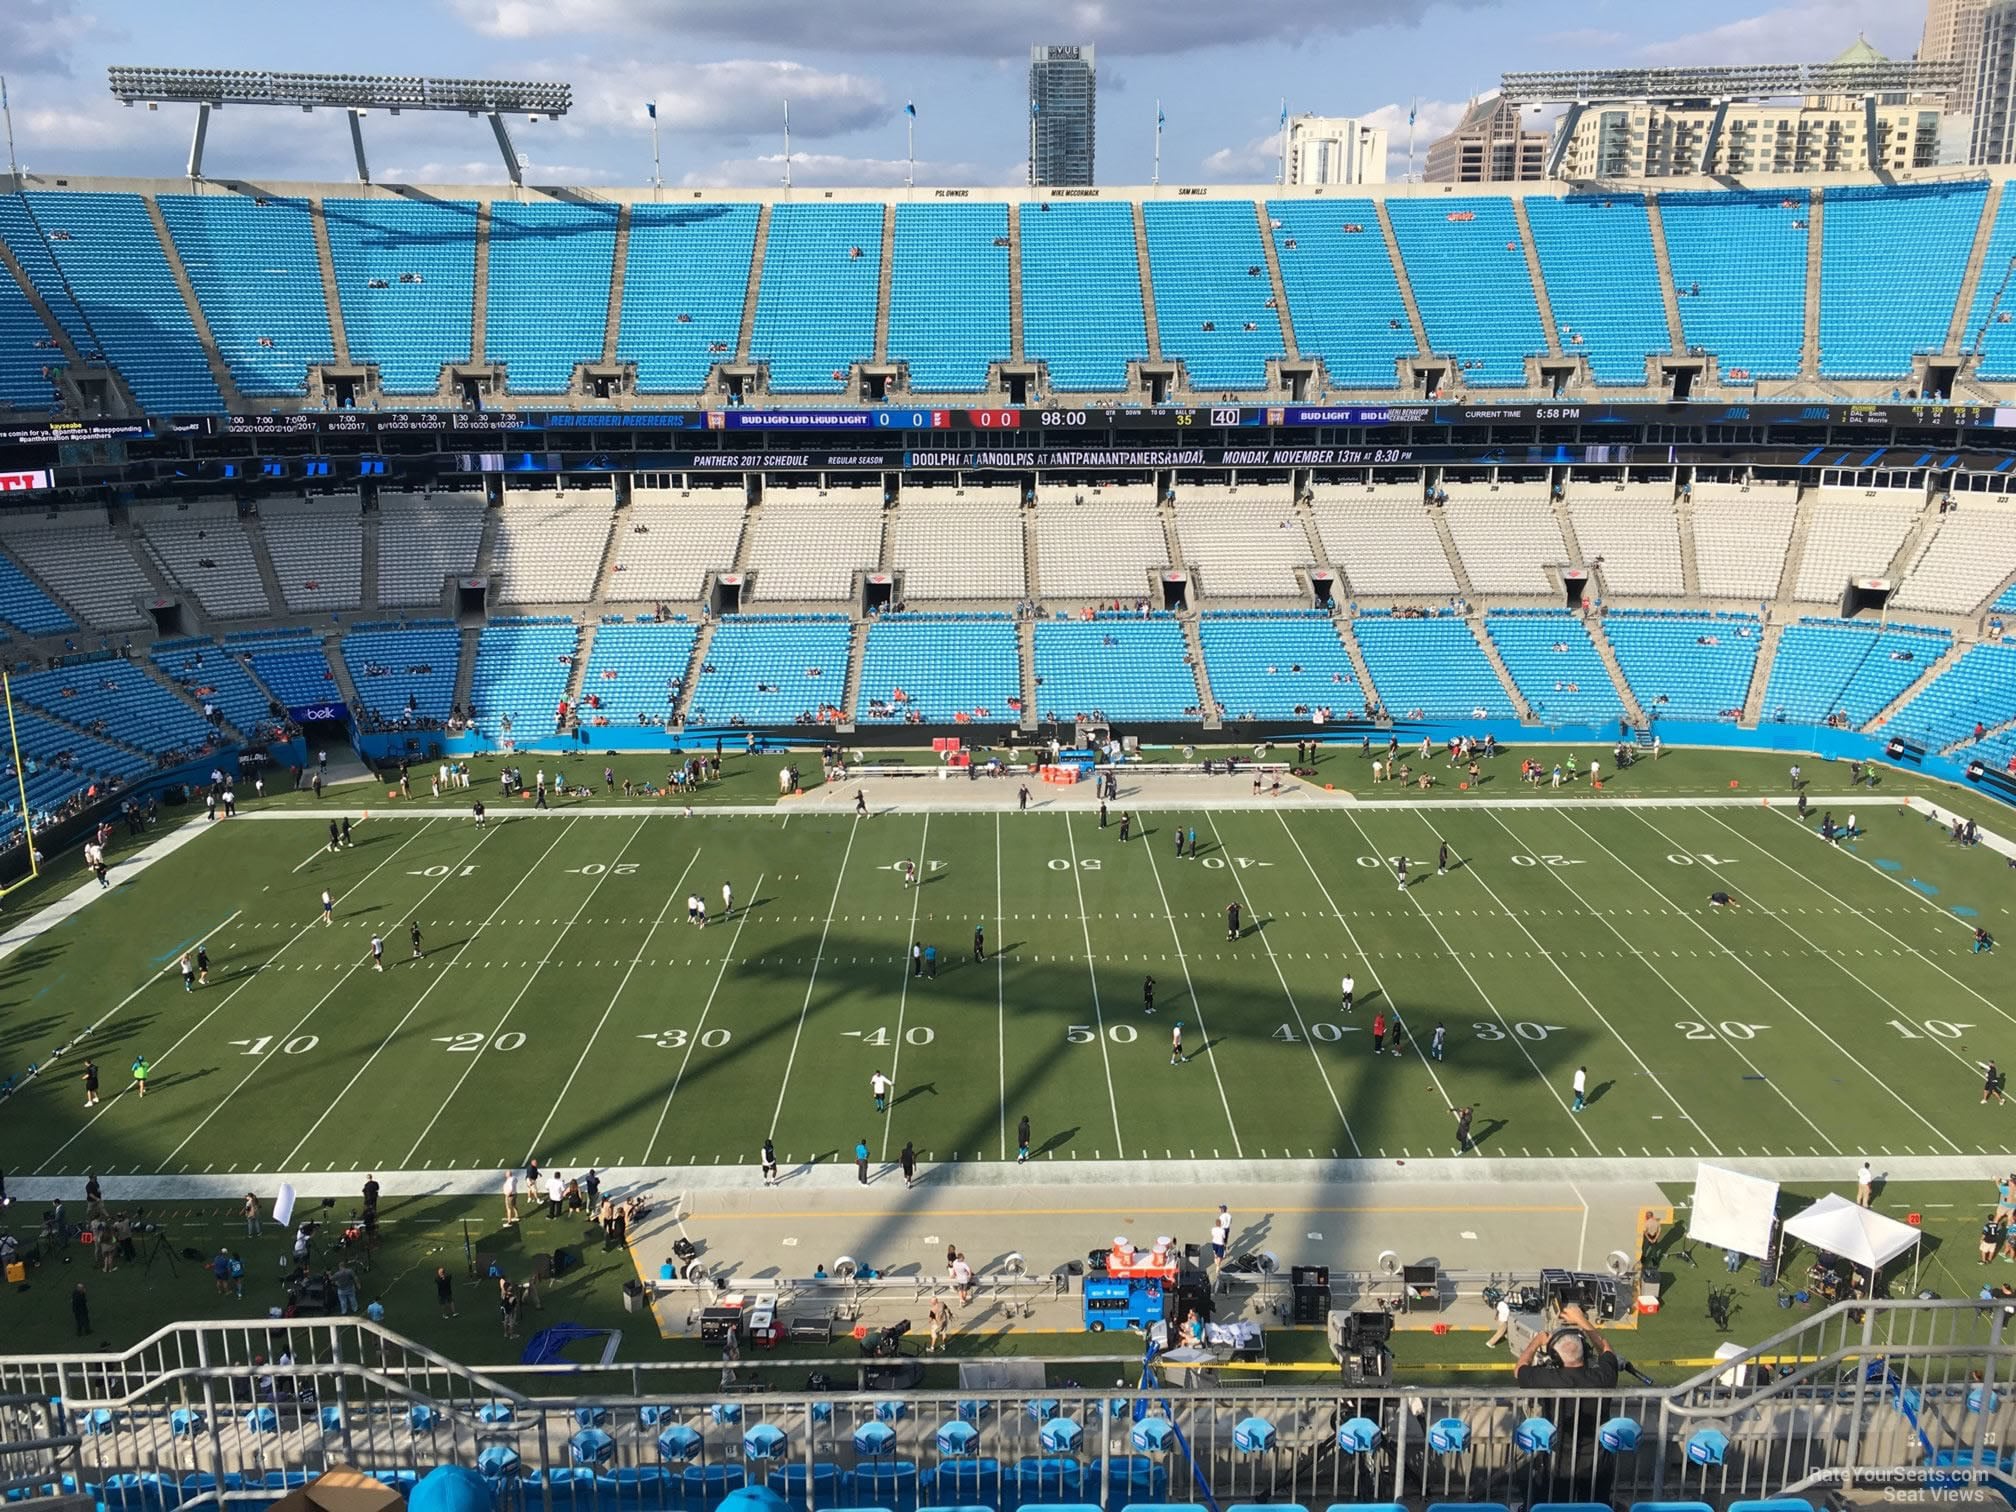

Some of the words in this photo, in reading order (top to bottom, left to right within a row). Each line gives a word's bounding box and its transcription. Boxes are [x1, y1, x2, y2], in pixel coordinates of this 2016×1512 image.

[500, 413, 516, 421] 7:30
[741, 416, 761, 424] BUD
[839, 416, 867, 424] LIGHT
[880, 413, 890, 426] 0
[913, 413, 923, 426] 0
[981, 413, 991, 425] 0
[1001, 413, 1011, 425] 0
[1041, 412, 1087, 425] 98:00
[1176, 415, 1192, 425] 35
[1215, 411, 1236, 424] 40
[1301, 412, 1321, 420] BUD
[1323, 412, 1349, 420] LIGHT
[1536, 409, 1559, 418] 5:58
[1562, 409, 1580, 418] PM
[328, 422, 365, 430] 8/10/2017
[411, 421, 446, 429] 8/10/2017
[693, 455, 738, 466] PANTHERS
[740, 455, 761, 466] 2017
[763, 455, 809, 466] SCHEDULE
[828, 456, 857, 464] REGULAR
[858, 456, 884, 464] SEASON
[963, 453, 974, 465] AT
[1037, 453, 1048, 465] AT
[1222, 451, 1269, 464] MONDAY,
[1272, 450, 1333, 463] NOVEMBER
[1337, 450, 1360, 463] 13TH
[1374, 450, 1400, 462] 8:30
[1401, 452, 1412, 460] PM
[1048, 859, 1102, 871] 50
[1202, 856, 1256, 869] 40
[1511, 854, 1571, 867] 20
[1666, 853, 1725, 866] 10
[423, 864, 482, 878] 10
[580, 862, 641, 876] 20
[860, 1026, 936, 1046] 40
[1066, 1025, 1139, 1044] 50
[1271, 1023, 1344, 1043] 40
[1471, 1021, 1549, 1042] 30
[1673, 1021, 1756, 1041] 20
[1885, 1019, 1964, 1040] 10
[239, 1035, 320, 1055] 10
[446, 1031, 527, 1052] 20
[655, 1028, 733, 1049] 30
